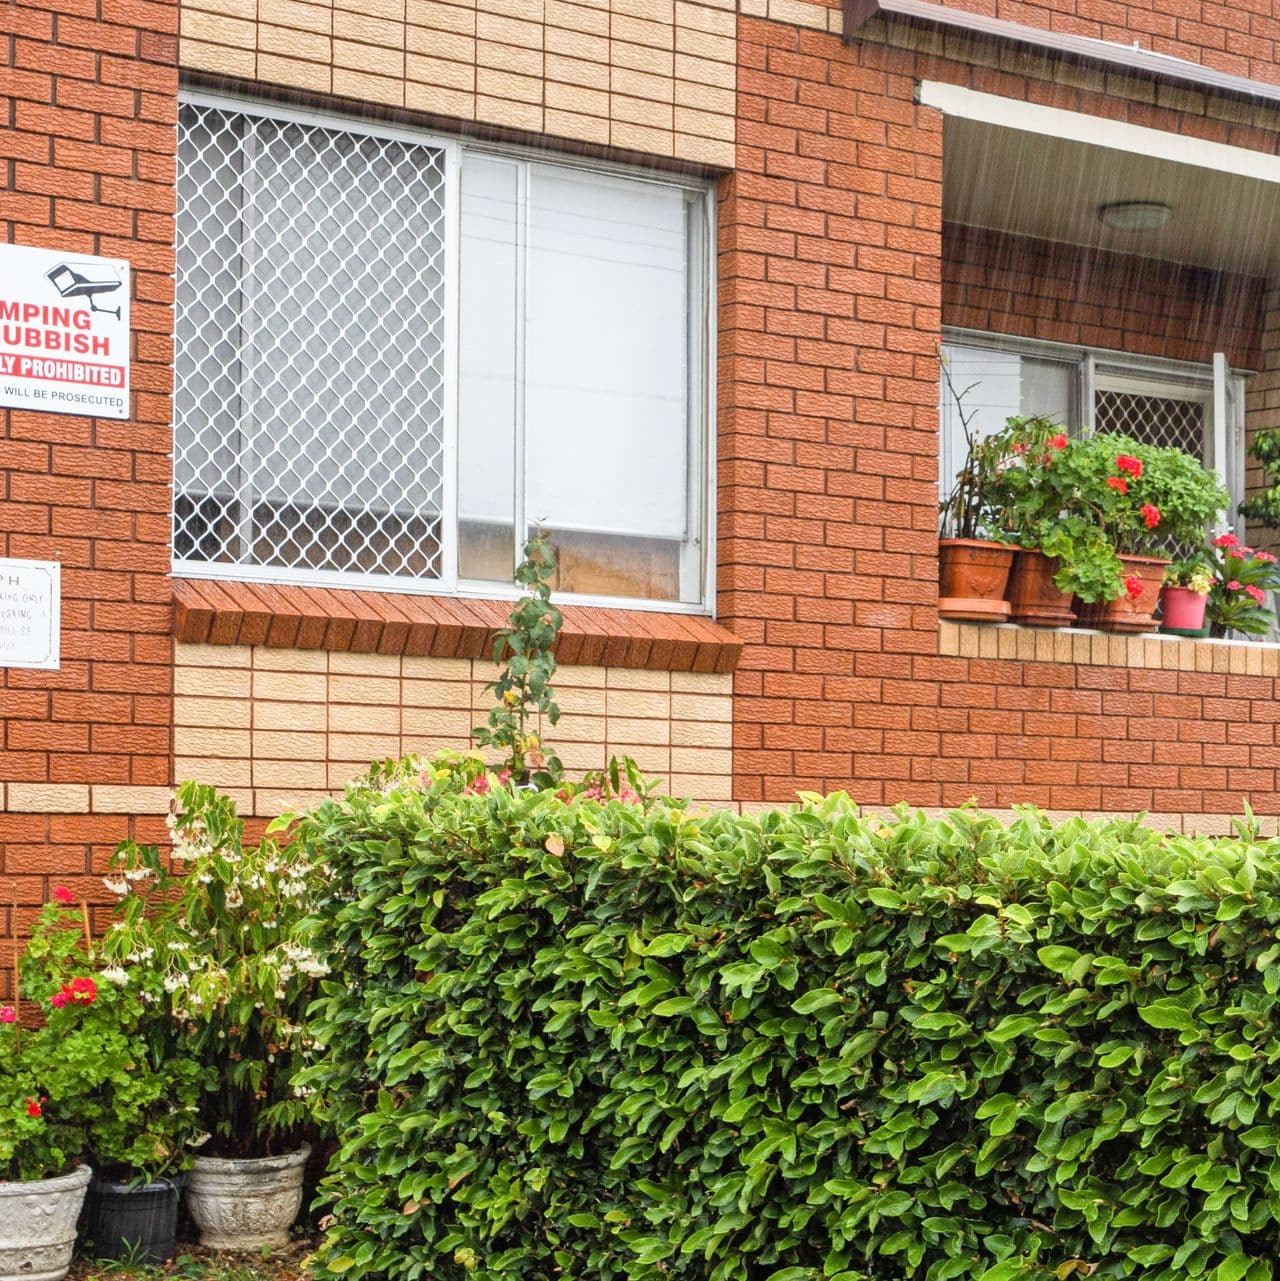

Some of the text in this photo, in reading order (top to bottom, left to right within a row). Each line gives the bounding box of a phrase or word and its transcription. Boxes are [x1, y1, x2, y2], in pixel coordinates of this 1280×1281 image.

[21, 358, 122, 385] PROHIBITED
[4, 386, 30, 398] WILL
[33, 390, 48, 400] BE
[51, 391, 124, 407] PROSECUTED
